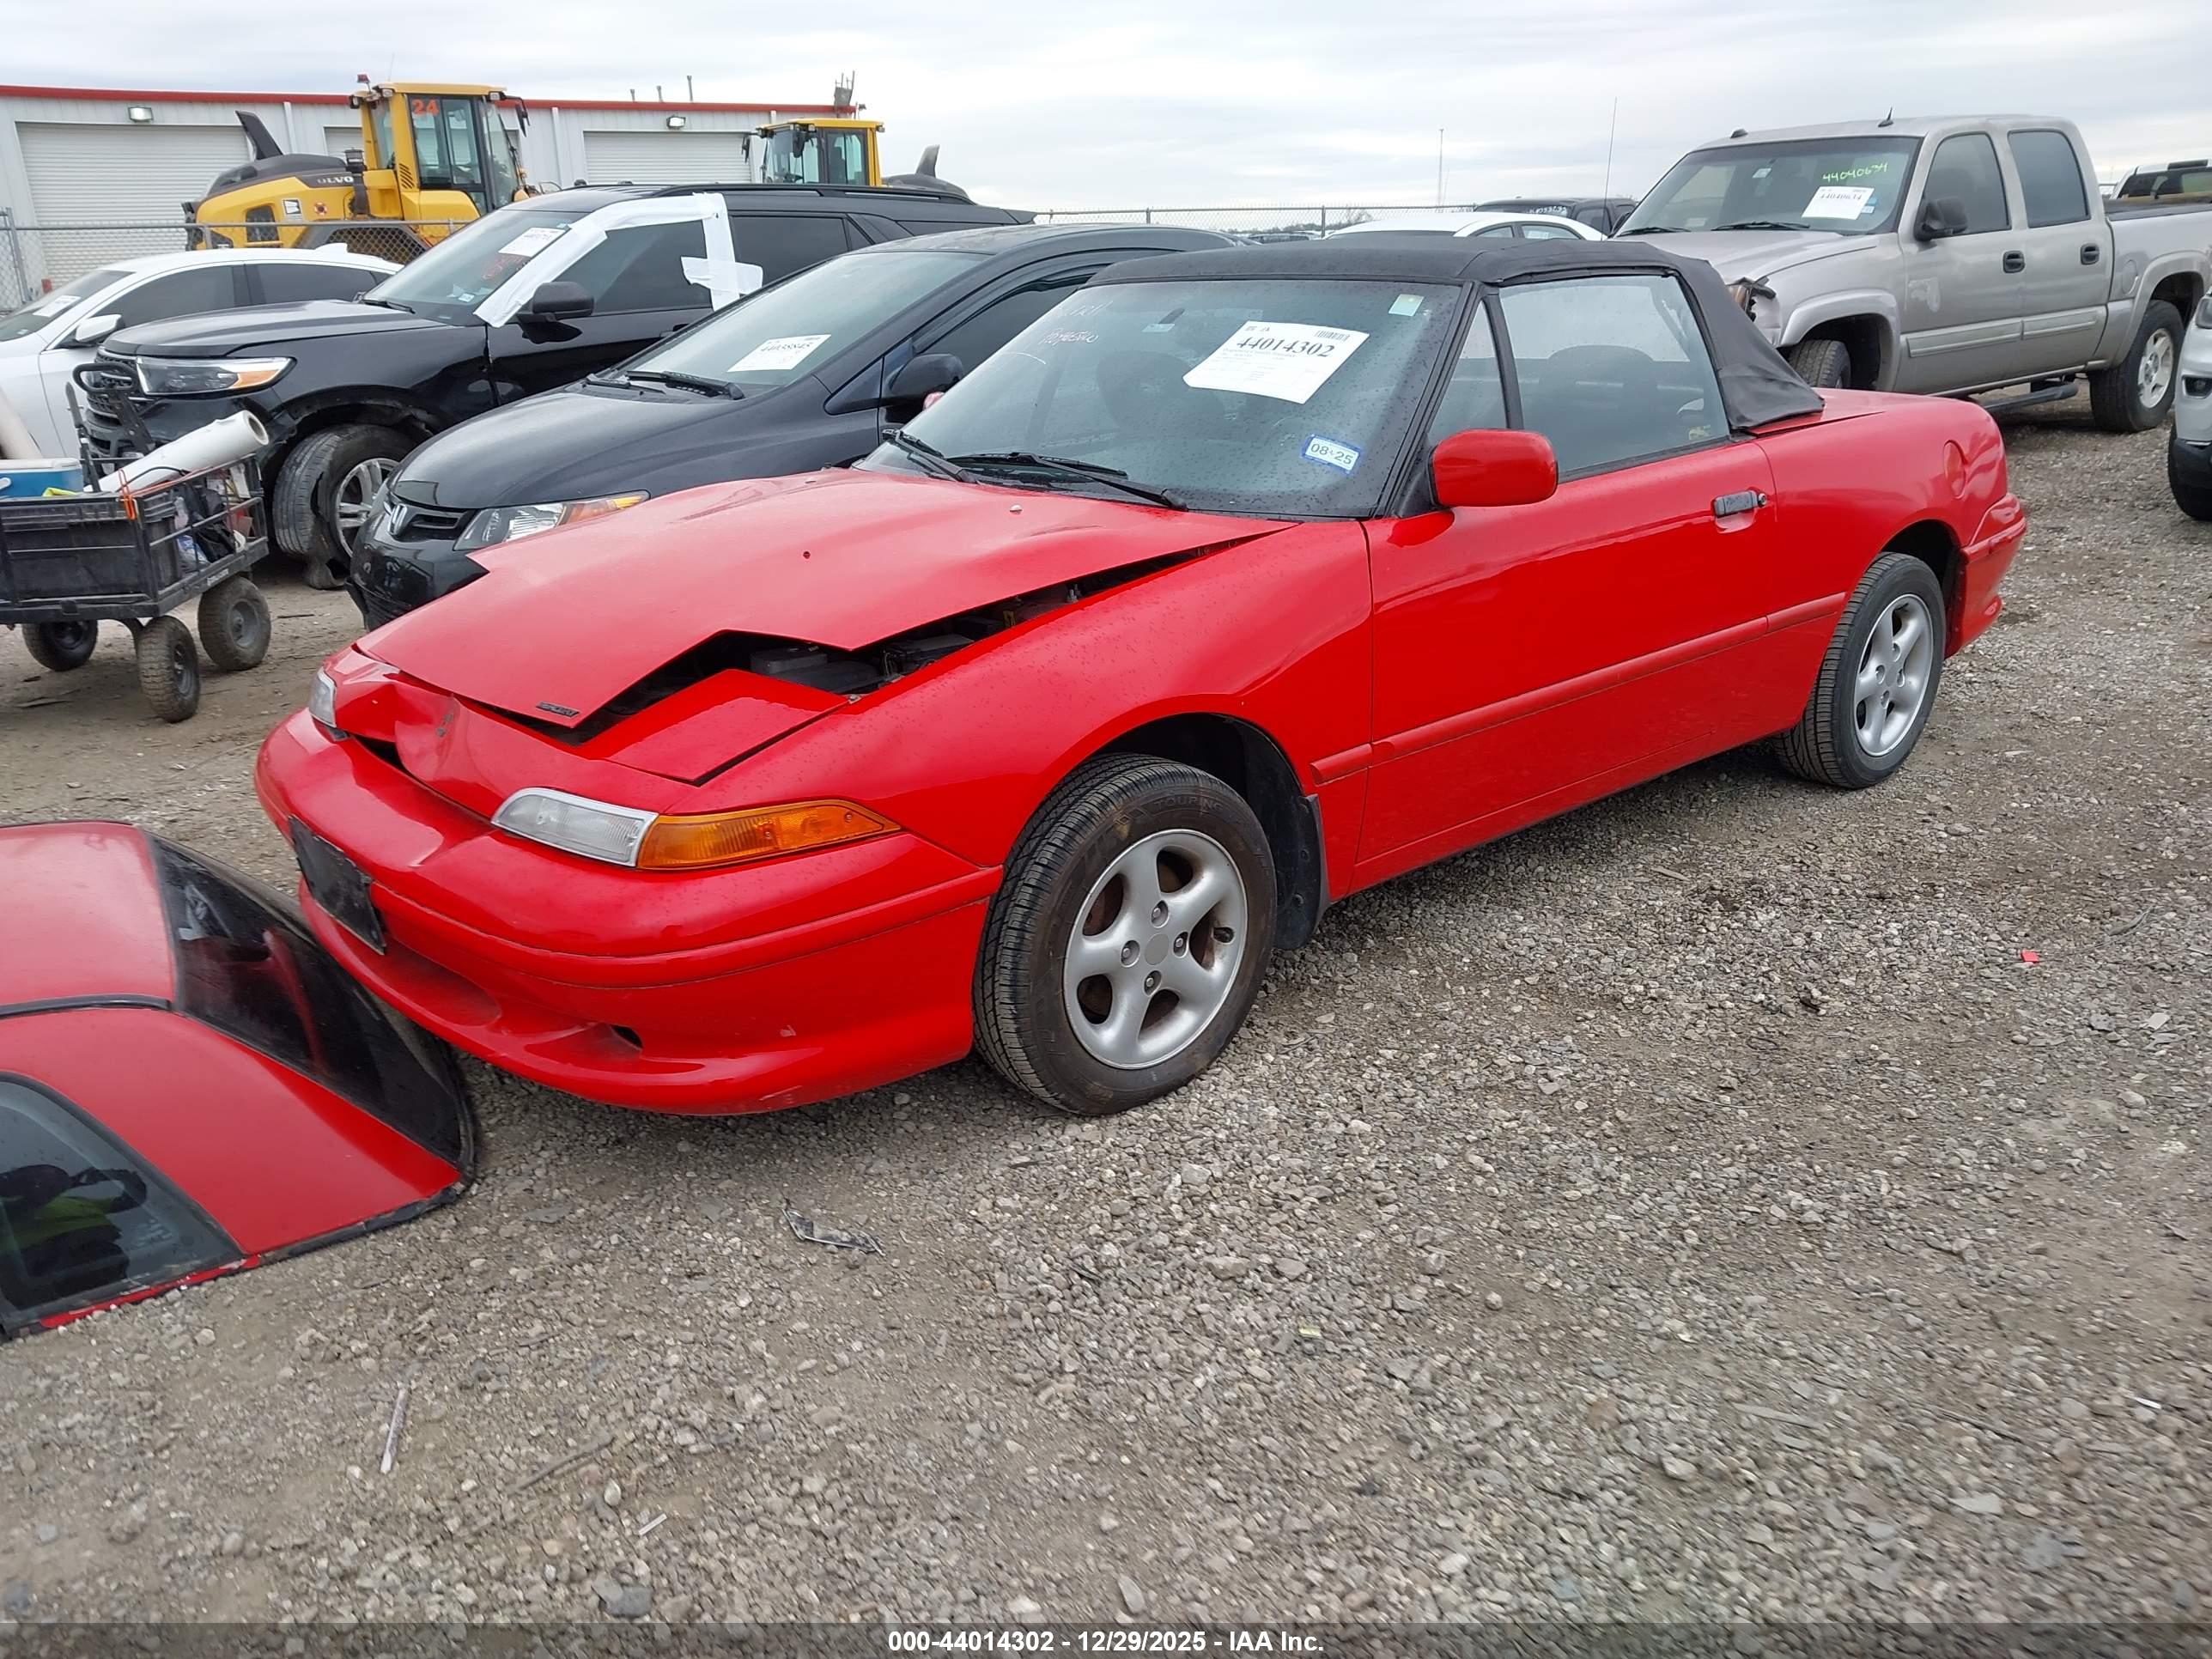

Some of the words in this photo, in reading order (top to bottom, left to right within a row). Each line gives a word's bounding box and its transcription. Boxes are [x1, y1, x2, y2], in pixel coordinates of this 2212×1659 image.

[412, 99, 439, 115] 24
[1822, 162, 1888, 182] 44040634
[1237, 336, 1335, 357] 44014302
[1152, 797, 1224, 811] TOURING
